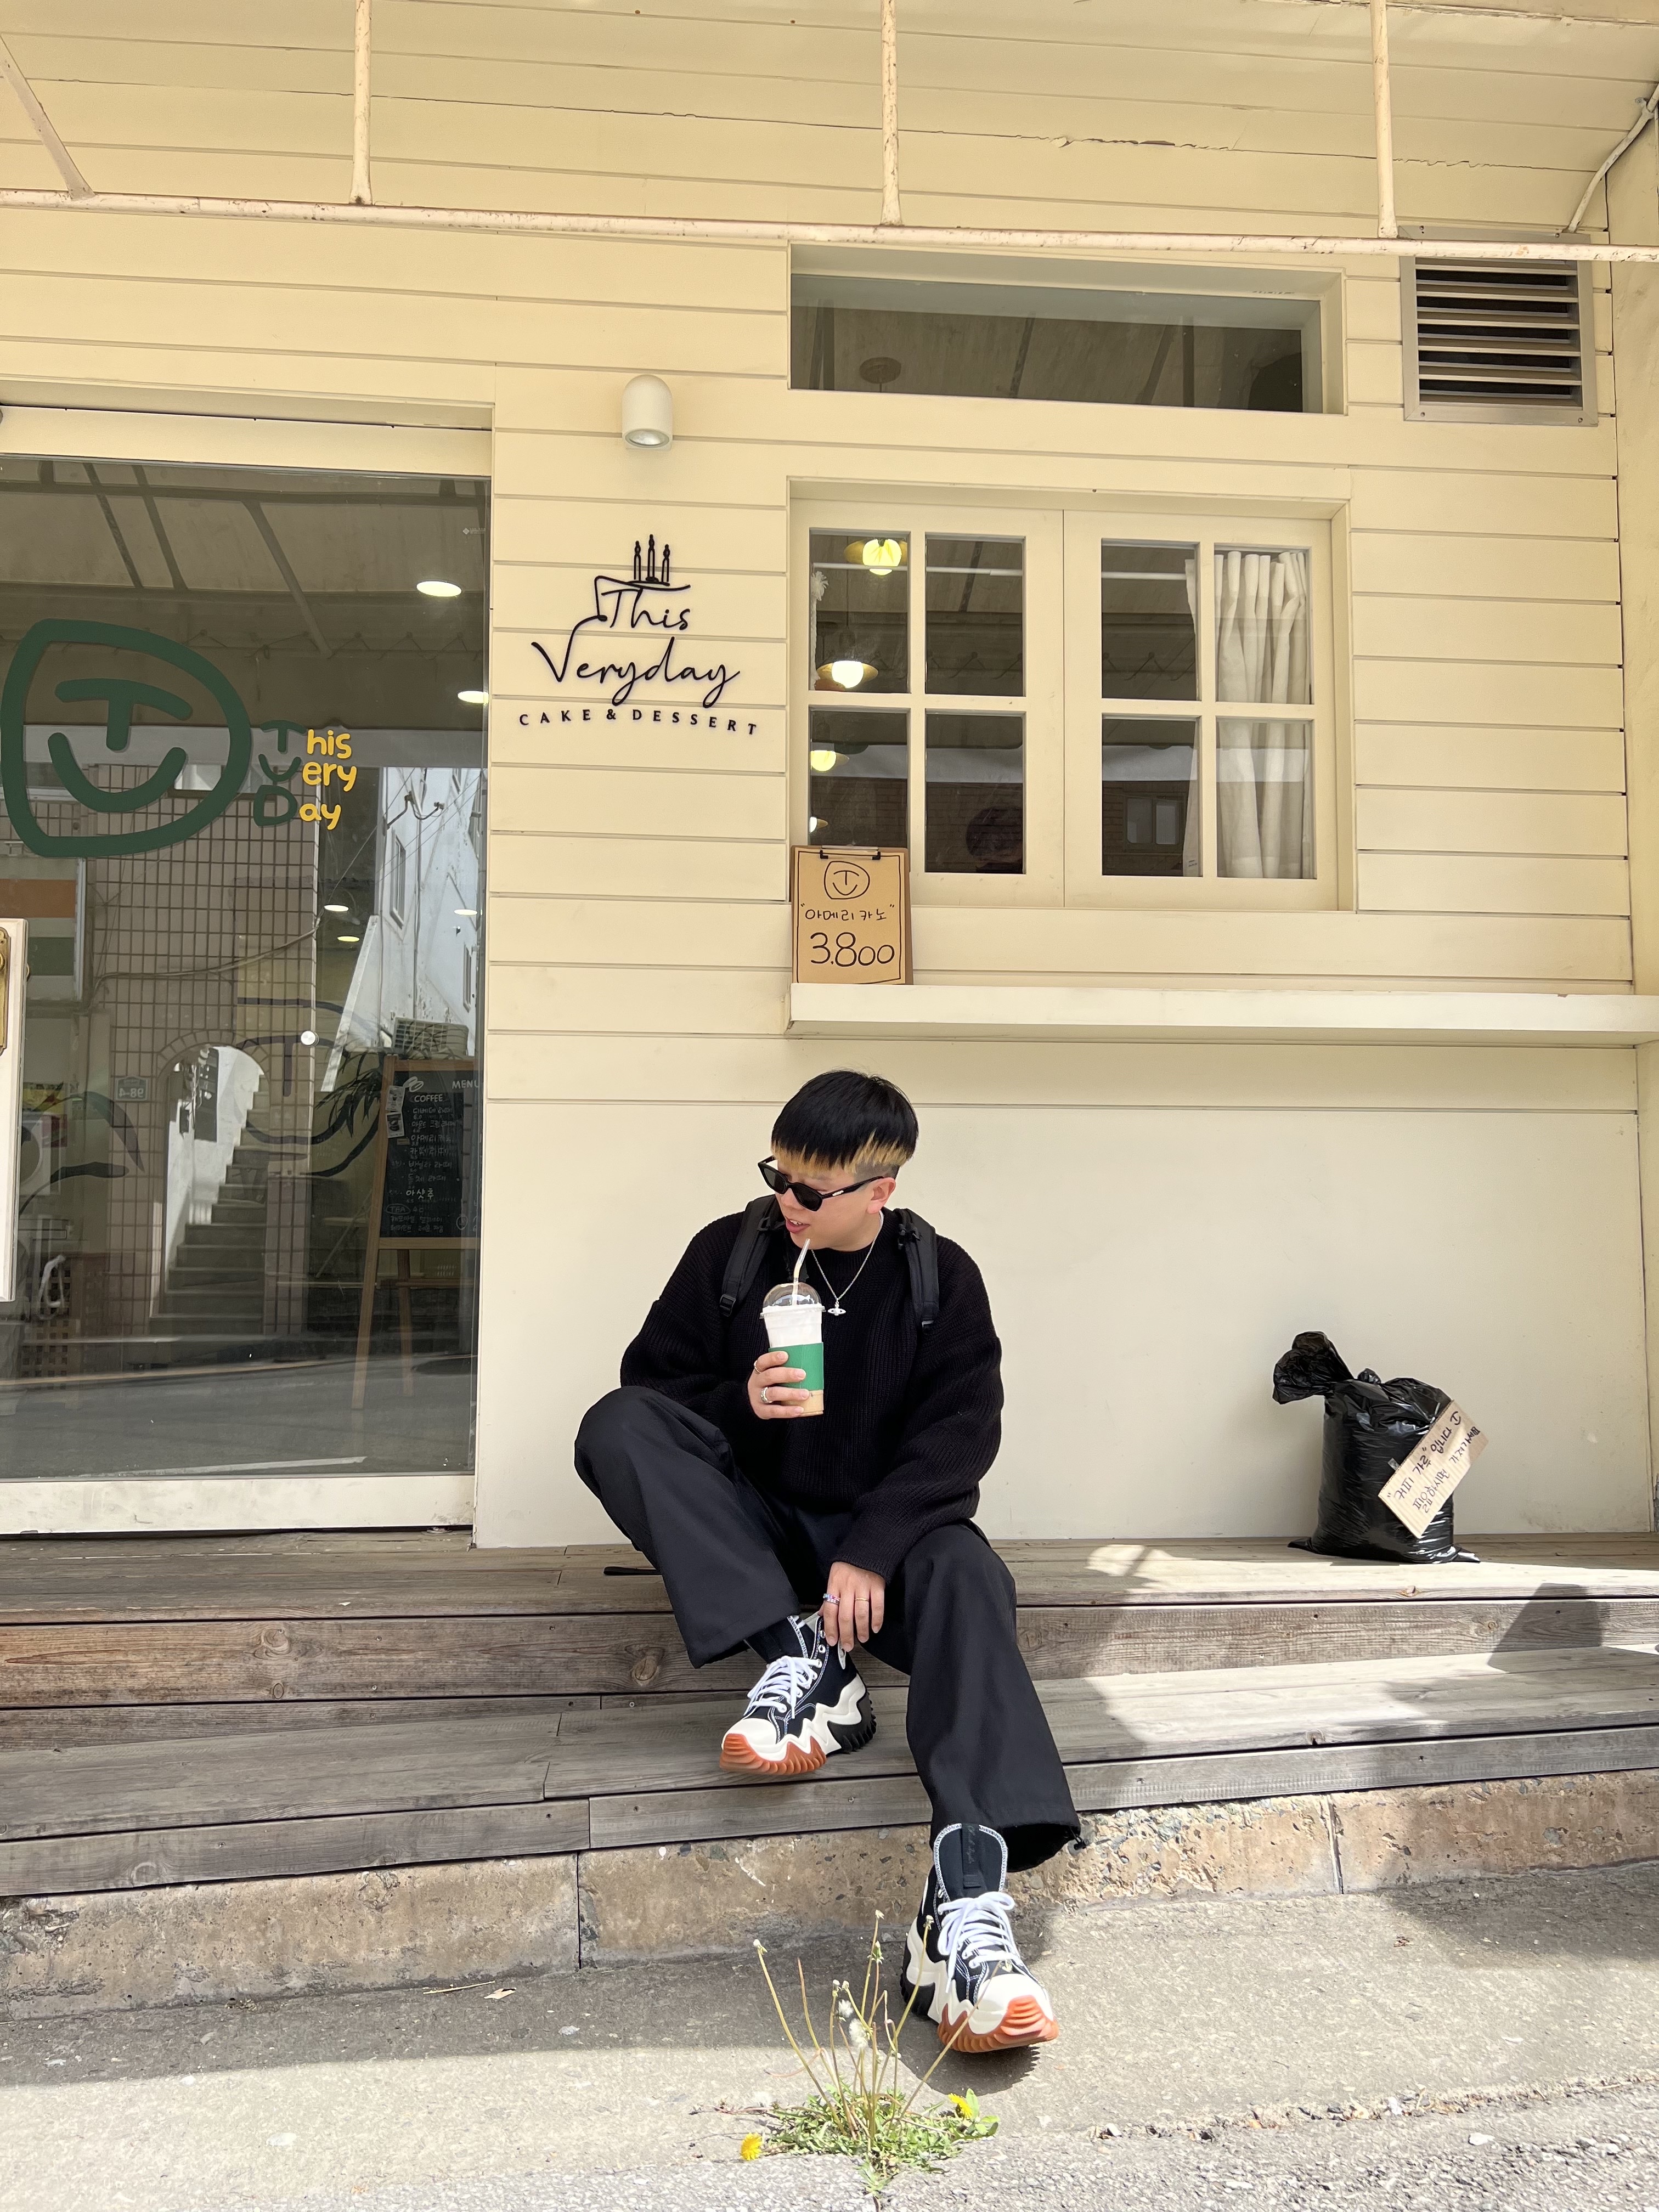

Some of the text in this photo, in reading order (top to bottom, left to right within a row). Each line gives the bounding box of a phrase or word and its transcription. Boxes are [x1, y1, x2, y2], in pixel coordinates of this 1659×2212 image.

[601, 586, 691, 630] This
[531, 635, 741, 708] Veryday
[519, 708, 757, 736] CAKE & DESSERT
[810, 932, 895, 967] 3.800
[414, 1094, 443, 1103] COFFEE
[408, 1160, 432, 1170] 바닐라
[406, 1188, 435, 1200] 아샷추
[1430, 1426, 1452, 1454] 입니다
[1412, 1469, 1450, 1513] 필요하시면
